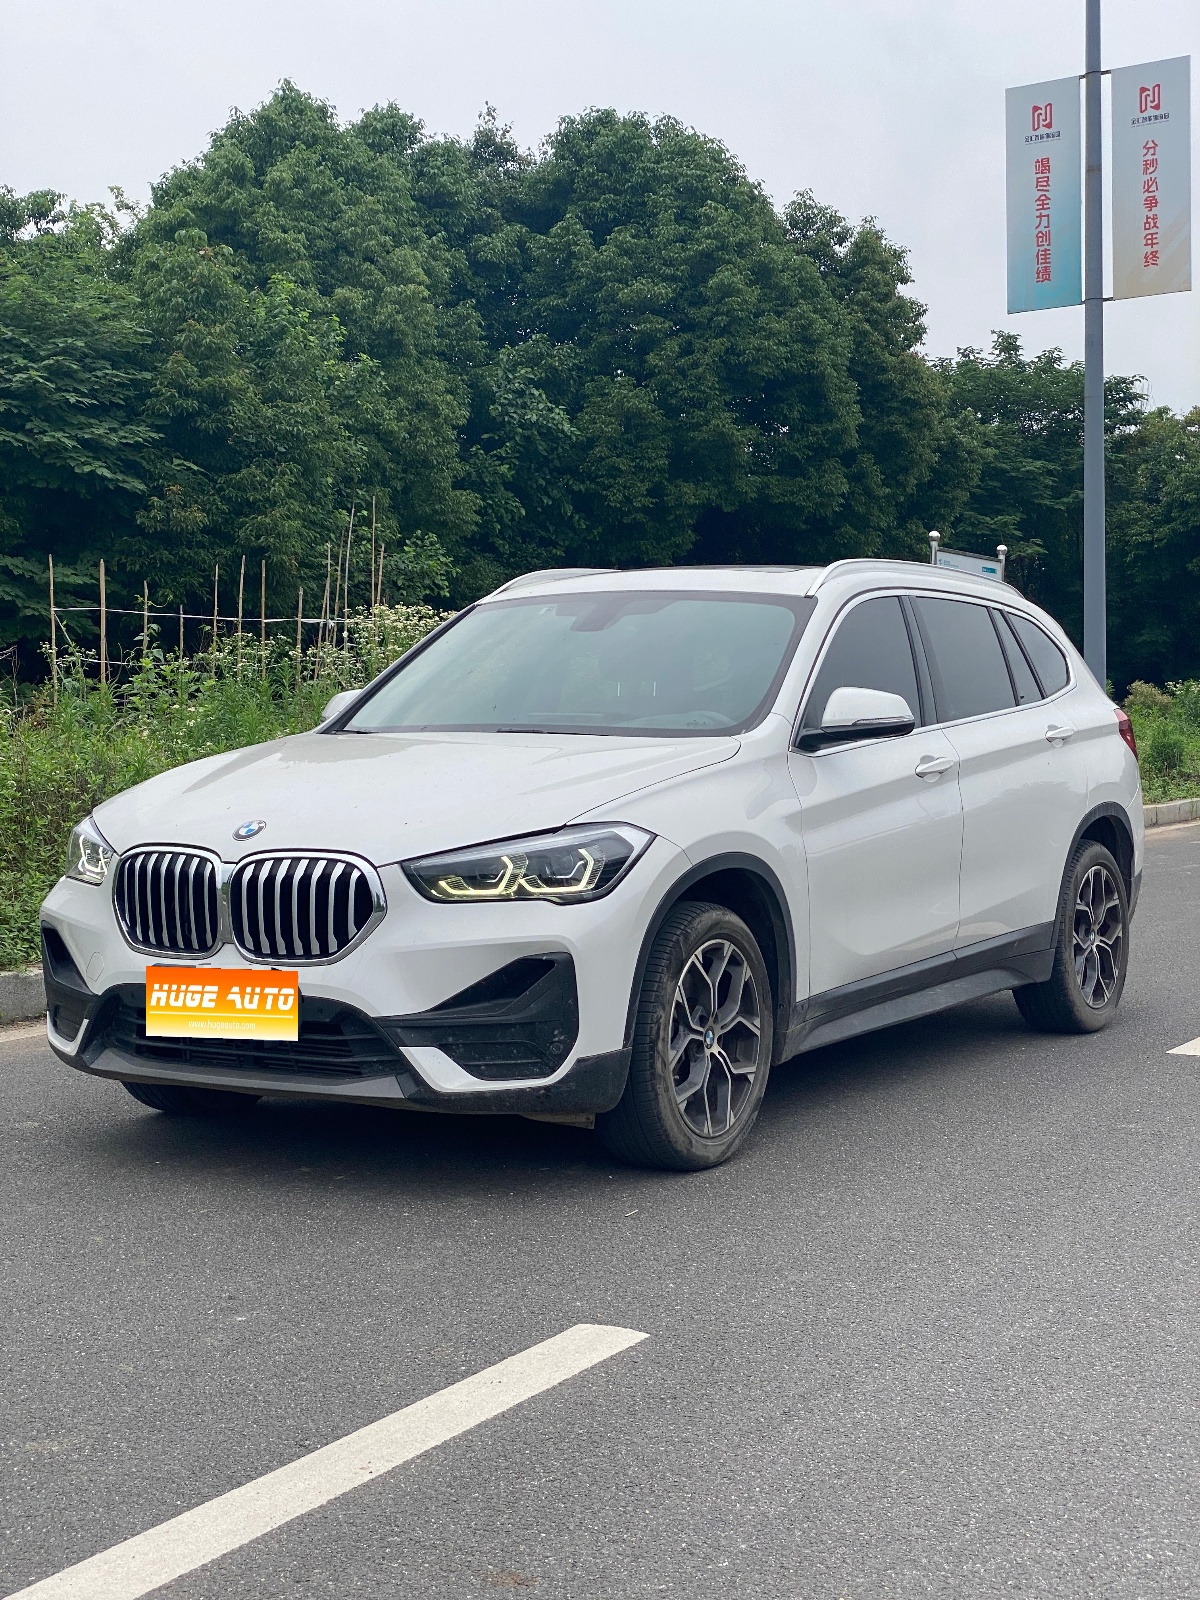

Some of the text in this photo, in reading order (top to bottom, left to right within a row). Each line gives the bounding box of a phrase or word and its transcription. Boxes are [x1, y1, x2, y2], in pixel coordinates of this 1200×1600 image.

[1034, 157, 1051, 283] 竭尽全力创佳绩
[1142, 139, 1159, 267] 分秒必争战年终
